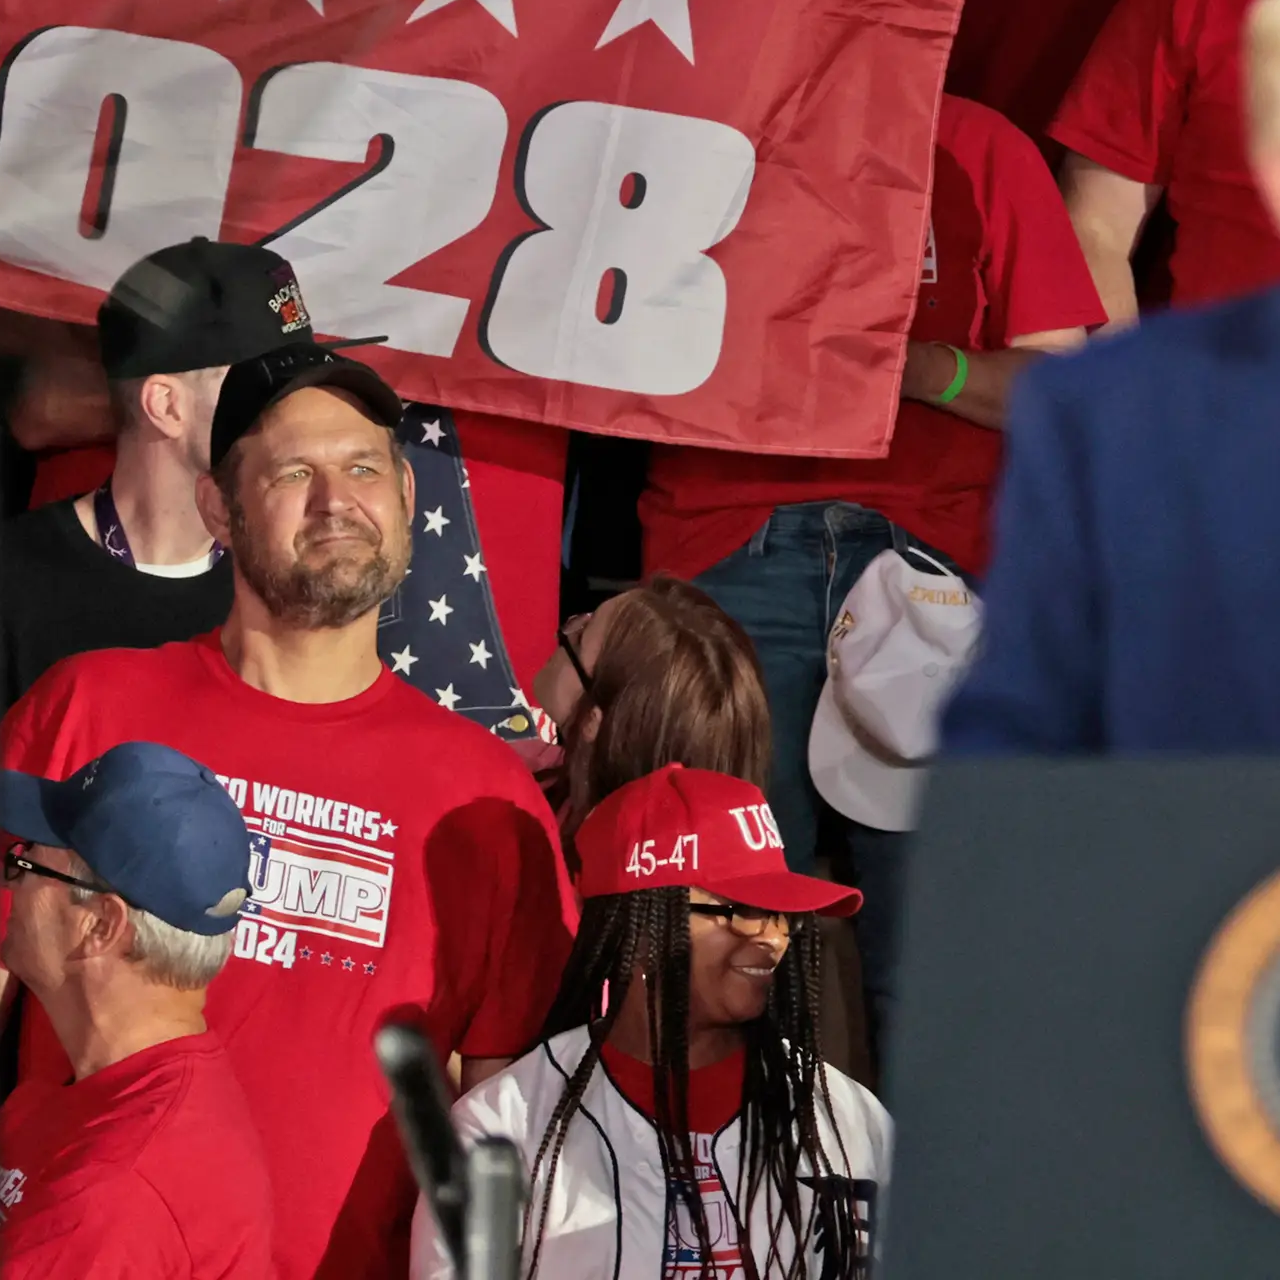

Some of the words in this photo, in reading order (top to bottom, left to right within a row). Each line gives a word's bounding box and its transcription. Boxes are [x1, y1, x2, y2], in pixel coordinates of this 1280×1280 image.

[252, 781, 381, 842] WORKERS
[262, 817, 286, 836] FOR
[625, 833, 699, 878] 45-47
